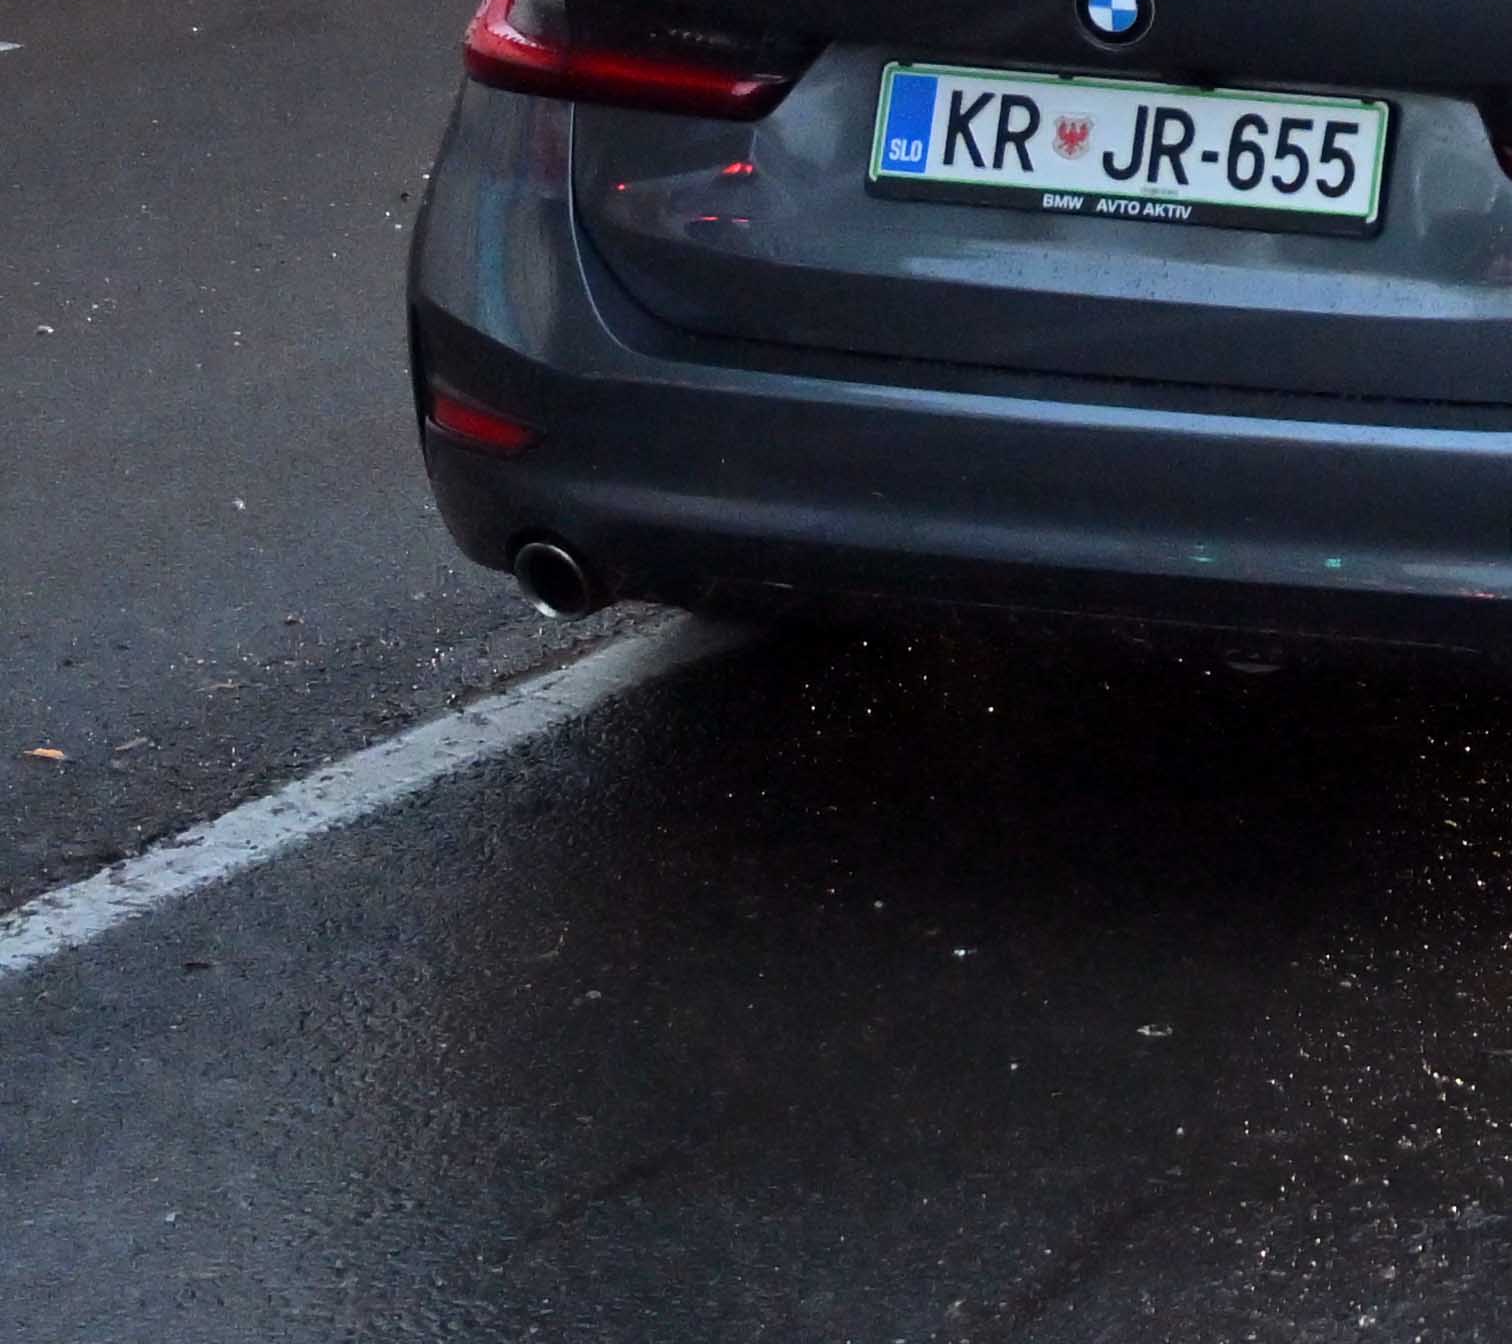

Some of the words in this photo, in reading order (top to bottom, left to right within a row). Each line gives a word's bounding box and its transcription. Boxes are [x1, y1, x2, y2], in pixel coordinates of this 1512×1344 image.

[888, 137, 924, 163] SLO
[942, 89, 1042, 173] KR
[1102, 104, 1360, 199] JR-655
[1042, 193, 1084, 210] BMW
[1096, 197, 1141, 216] AVTO
[1143, 202, 1193, 220] AKTIV
